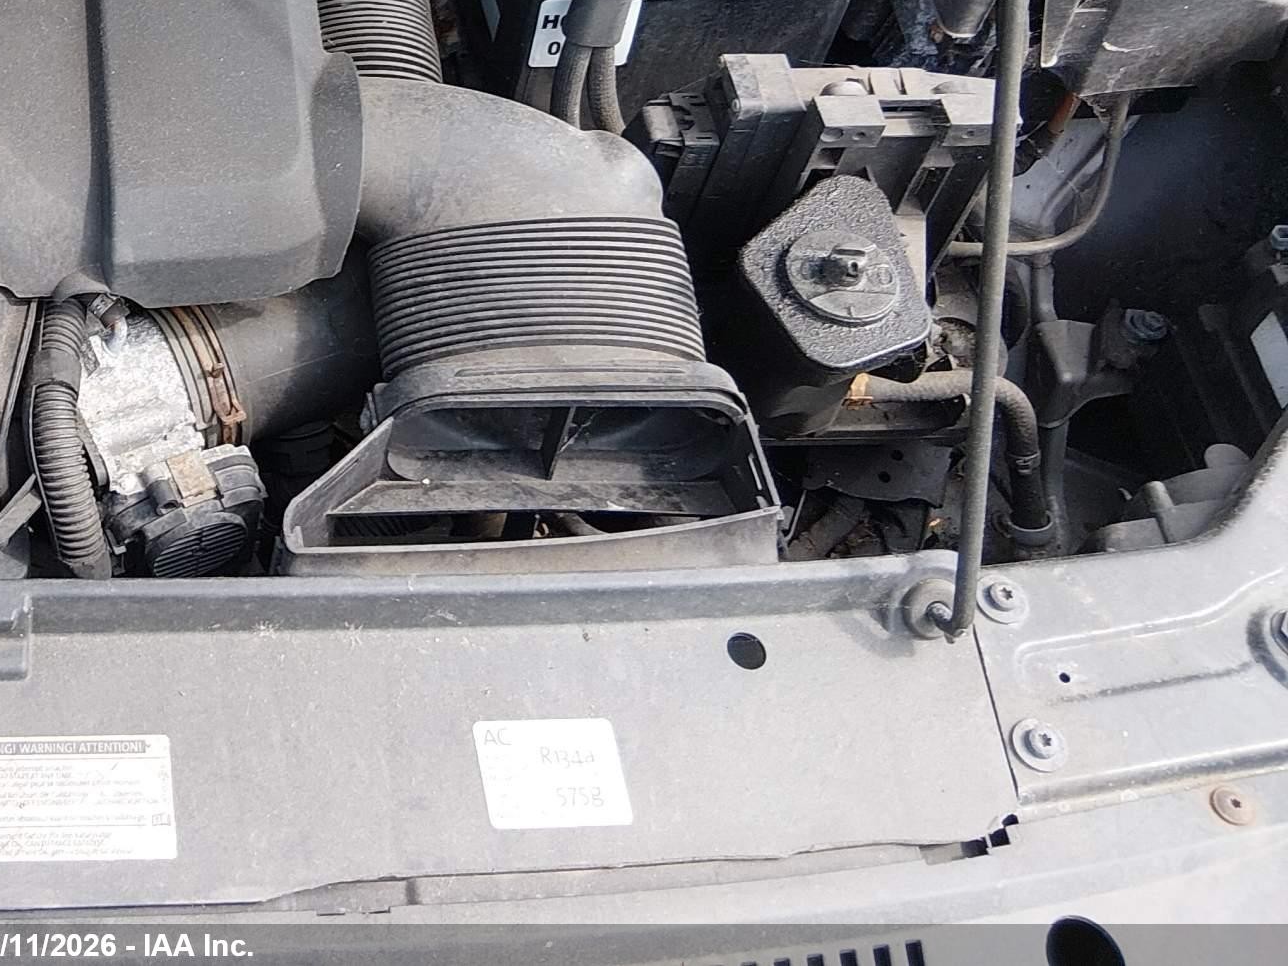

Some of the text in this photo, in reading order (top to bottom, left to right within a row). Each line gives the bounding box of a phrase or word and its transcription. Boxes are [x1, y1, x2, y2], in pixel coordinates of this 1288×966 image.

[483, 727, 512, 746] AC
[20, 743, 76, 754] WARNING!
[78, 742, 143, 754] ATTENTION!
[540, 745, 595, 769] R134a
